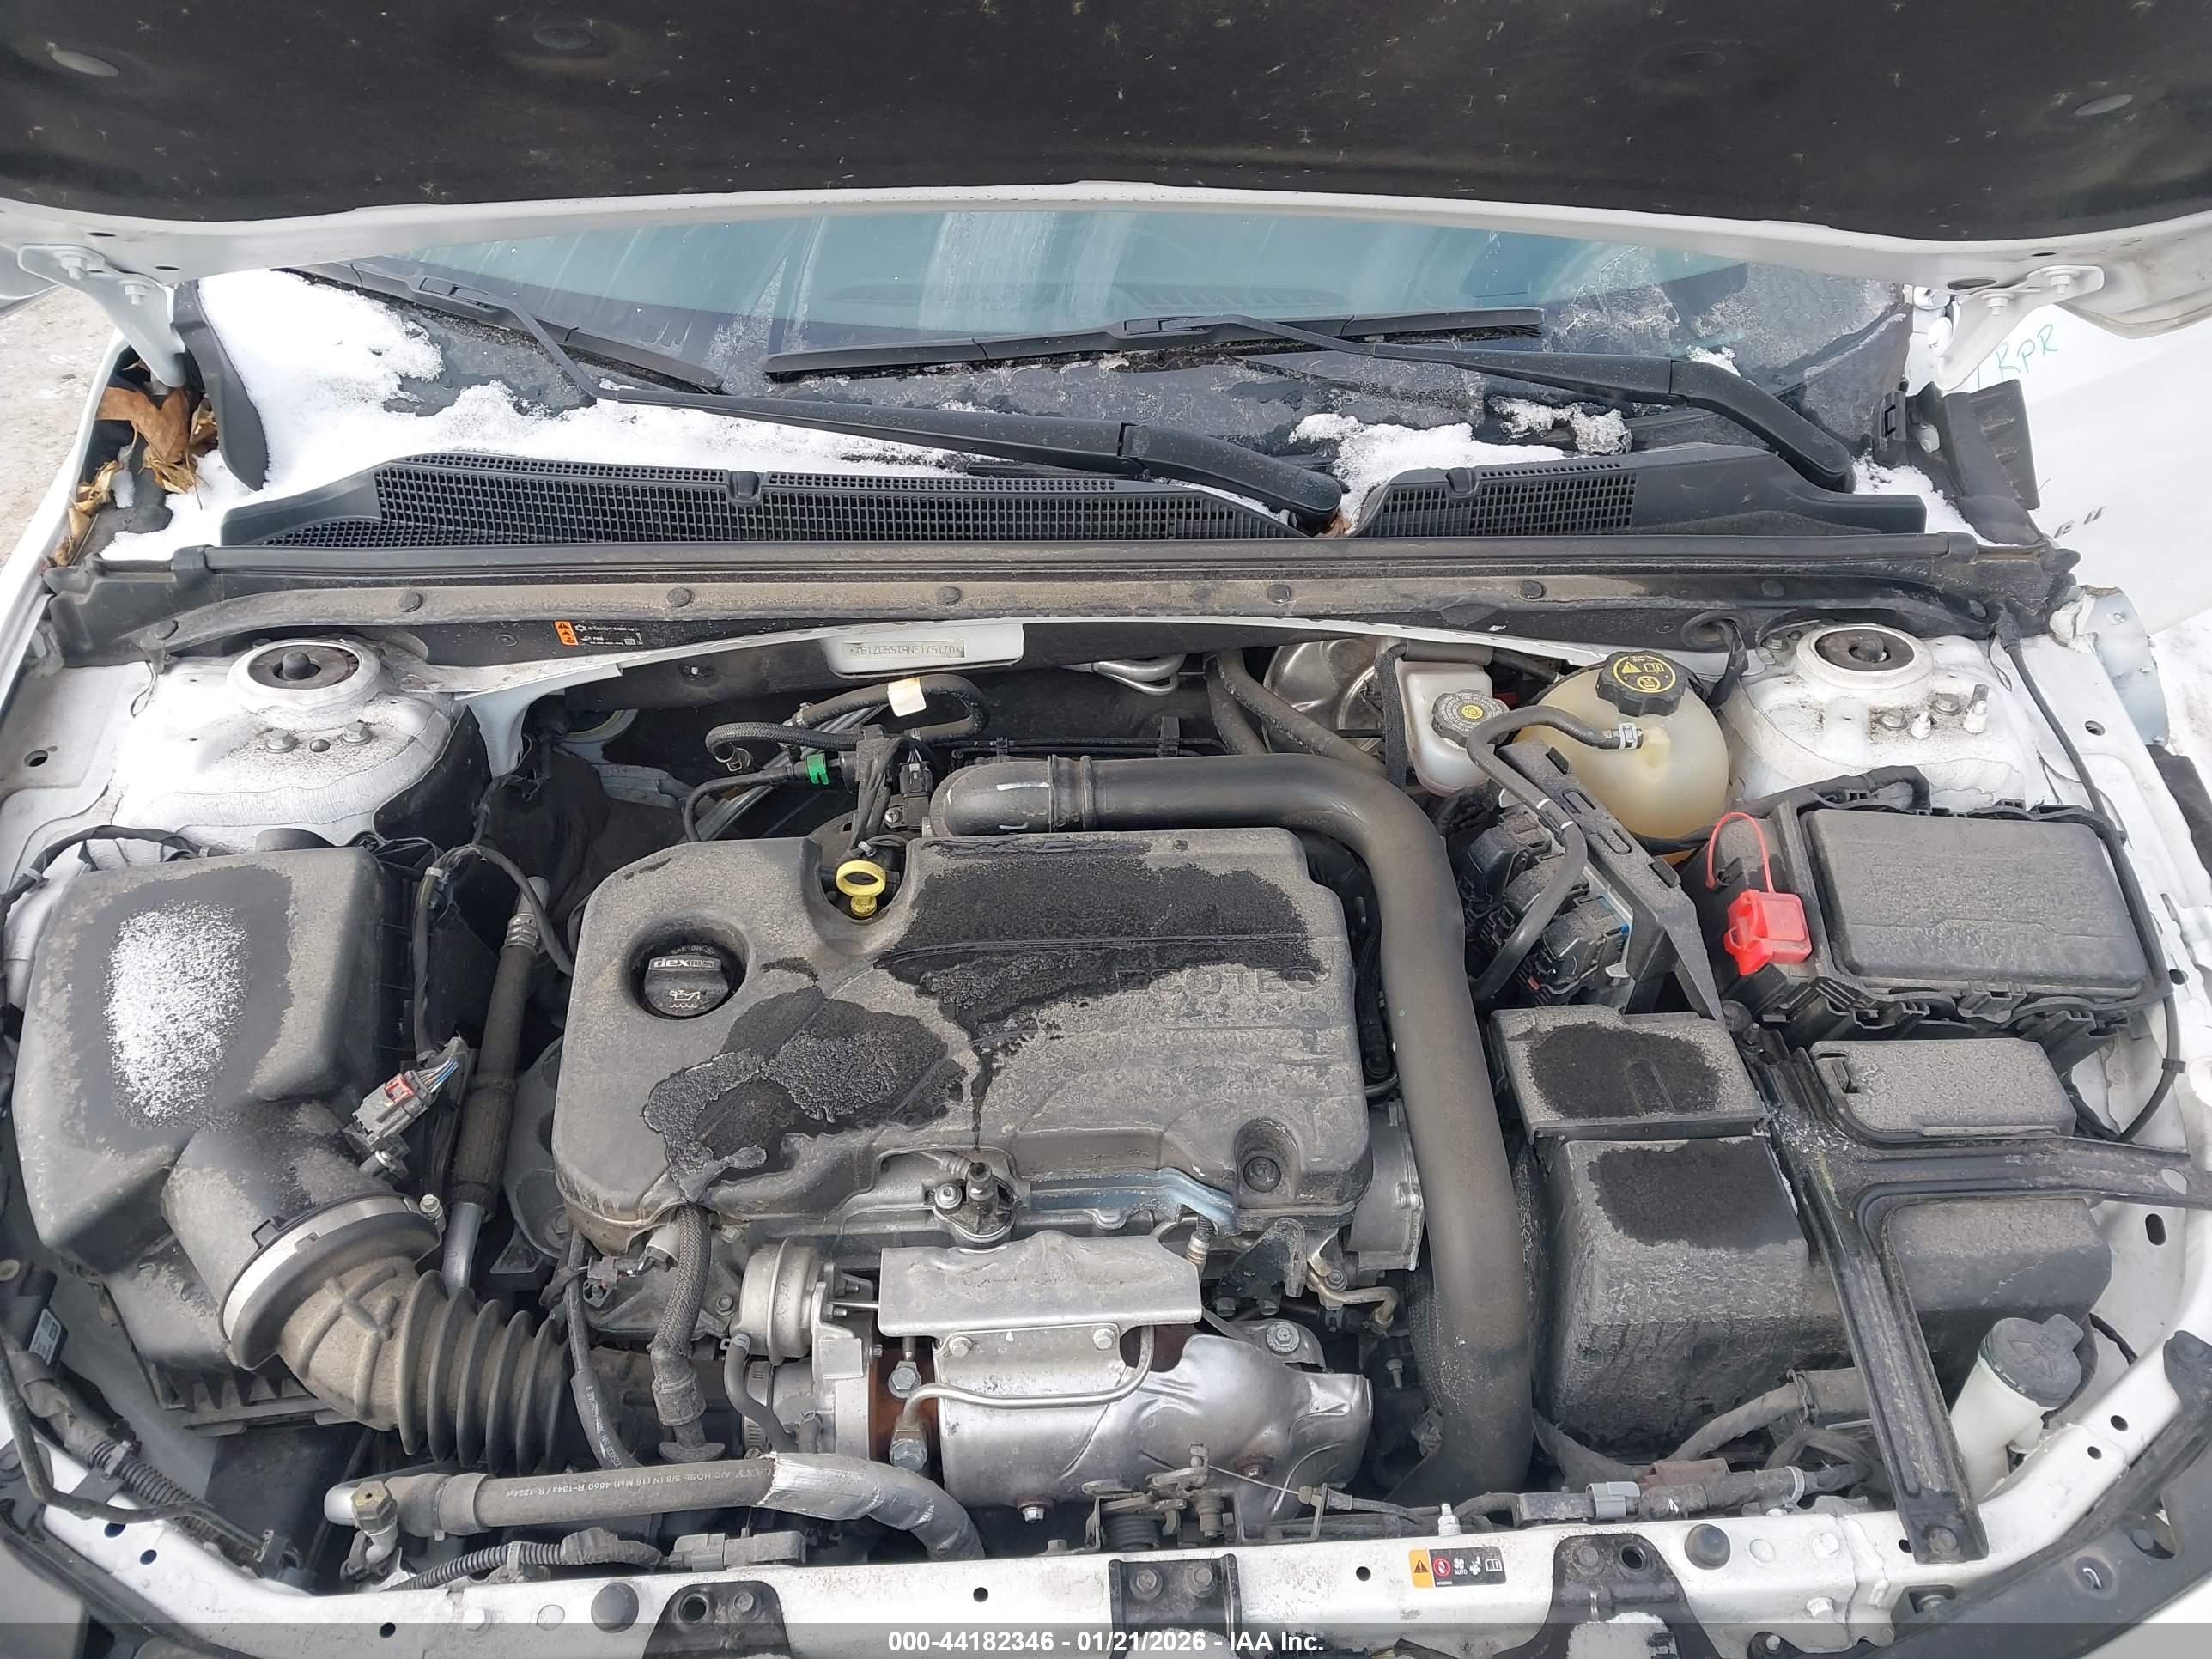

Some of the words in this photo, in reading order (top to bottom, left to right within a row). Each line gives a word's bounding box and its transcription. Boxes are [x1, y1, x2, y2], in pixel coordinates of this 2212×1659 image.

[1996, 324, 2058, 380] RPR
[653, 958, 714, 968] dexos
[1116, 965, 1320, 995] ECOTEC
